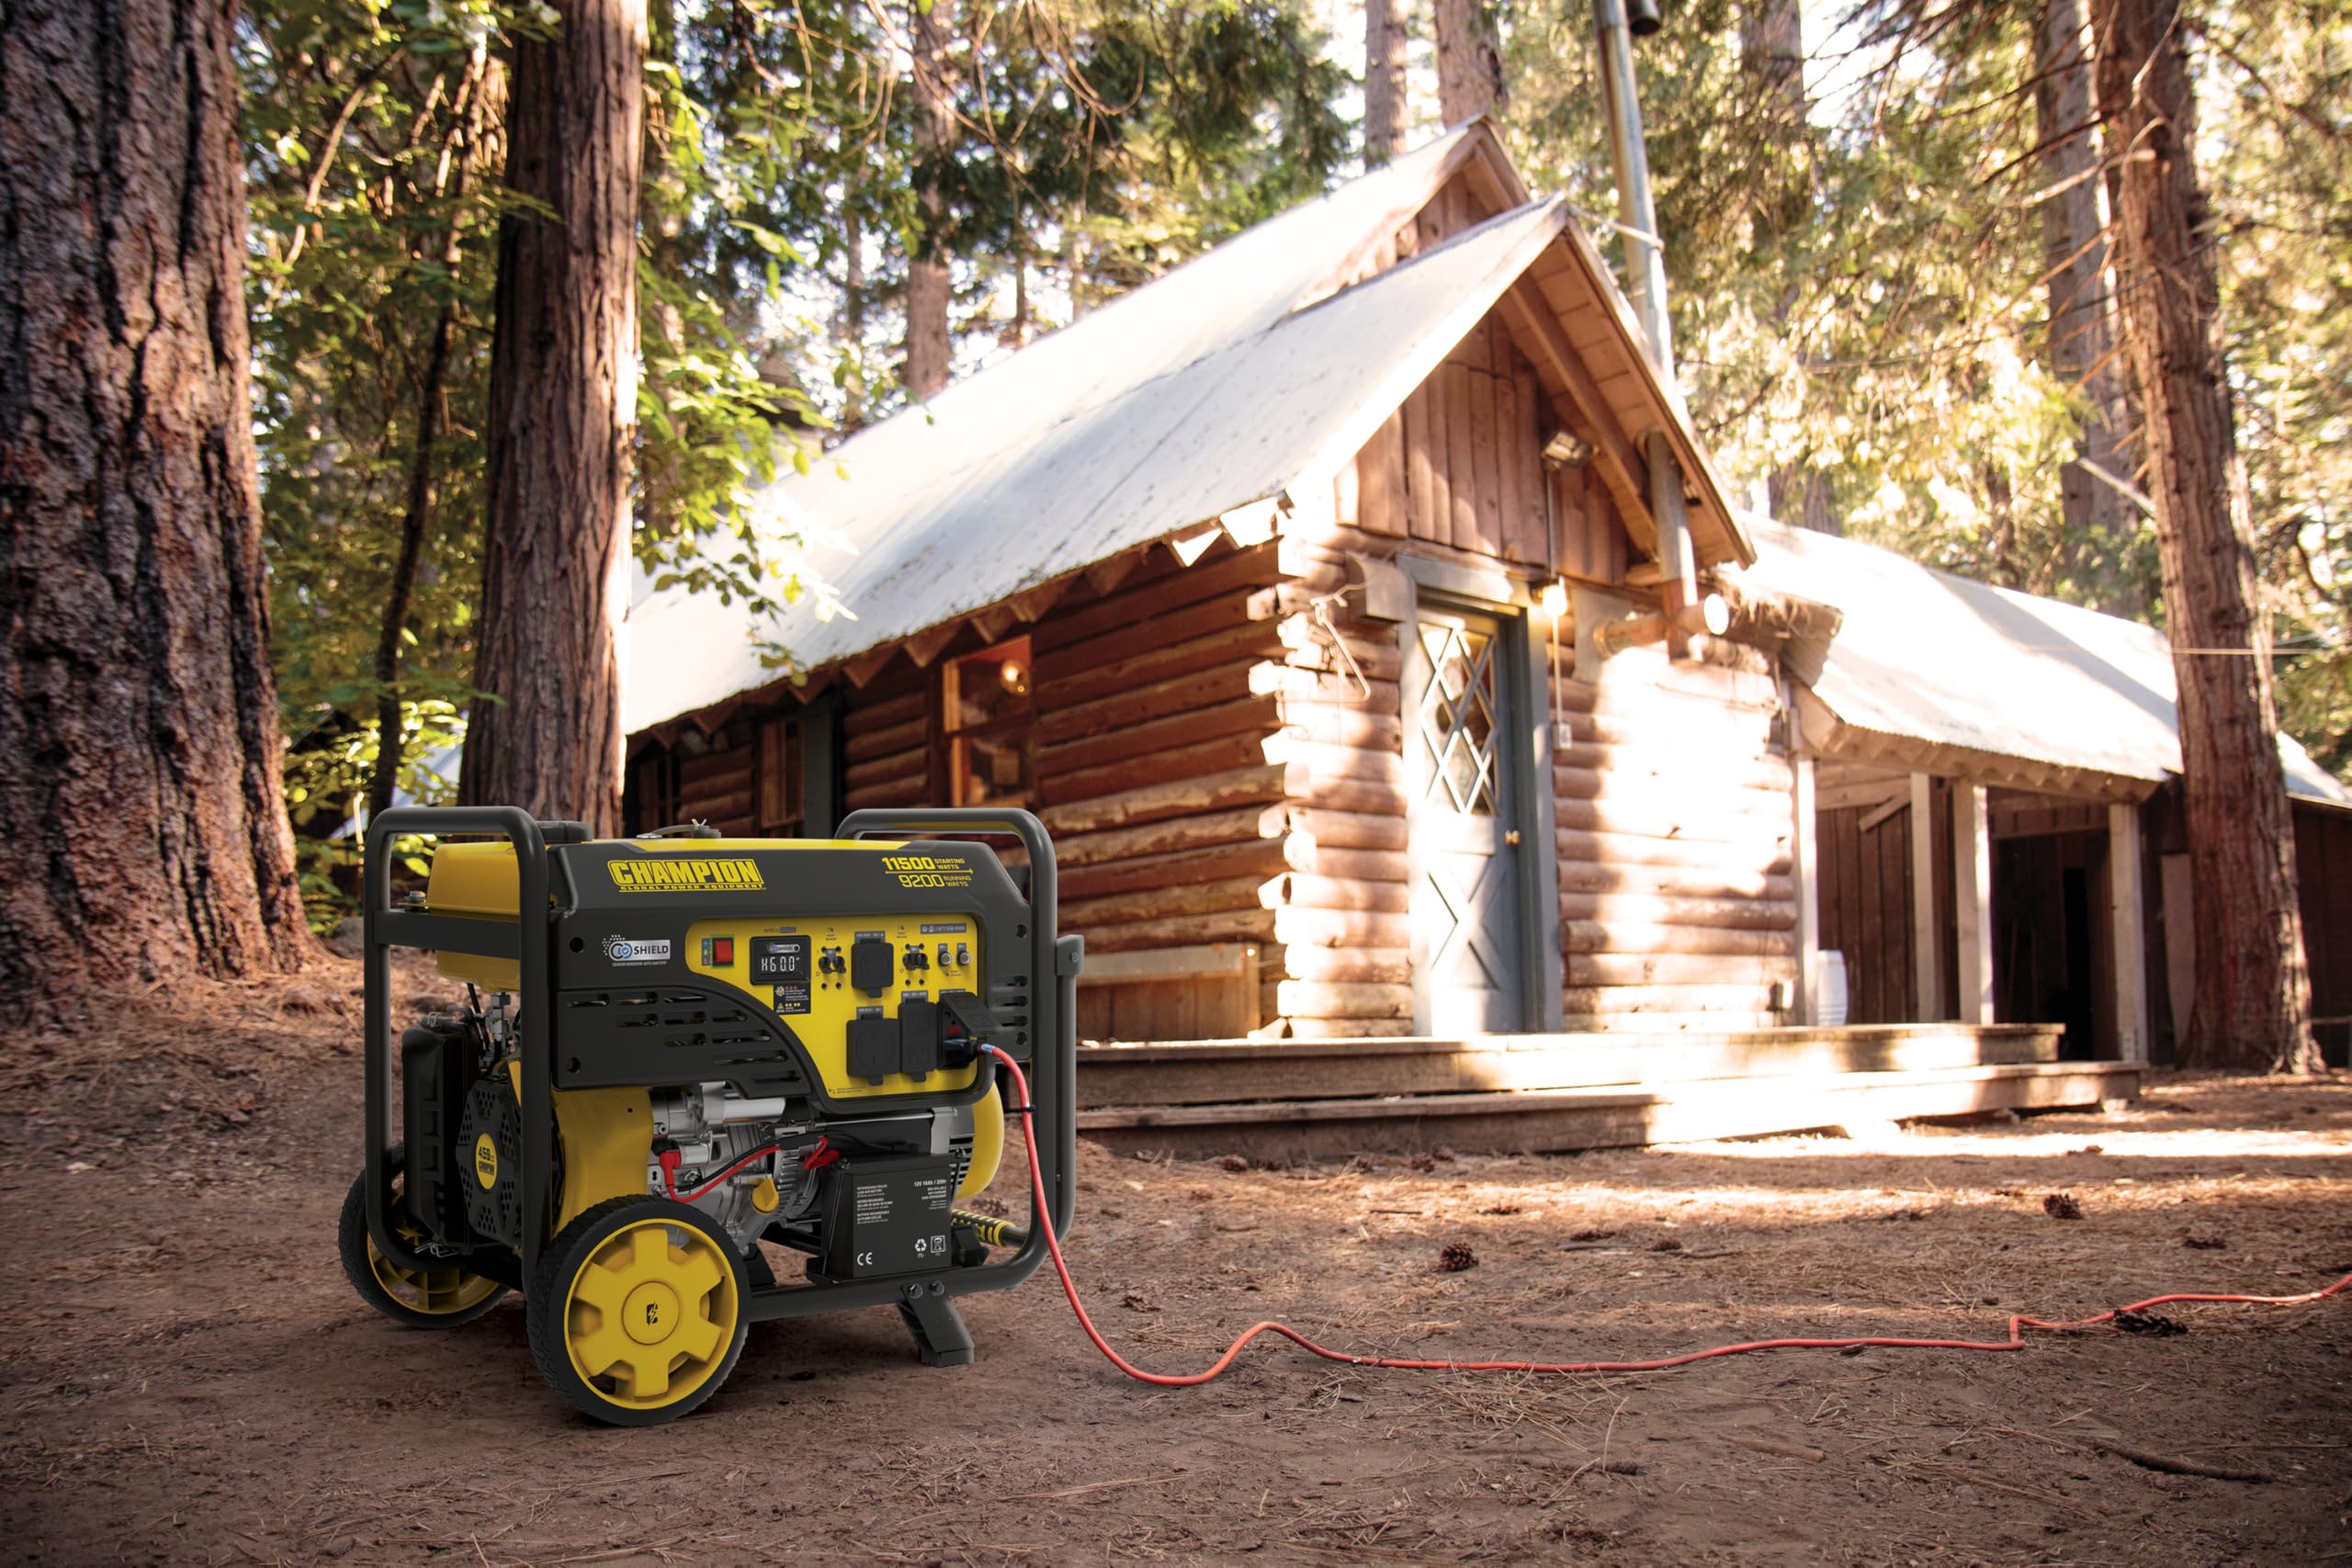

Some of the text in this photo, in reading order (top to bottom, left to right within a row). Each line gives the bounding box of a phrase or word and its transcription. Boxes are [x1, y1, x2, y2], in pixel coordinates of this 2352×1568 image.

[882, 857, 935, 870] 11500
[608, 861, 763, 885] CHAMPION
[899, 874, 944, 887] 9200
[634, 945, 669, 955] SHIELD
[856, 1251, 873, 1266] CE
